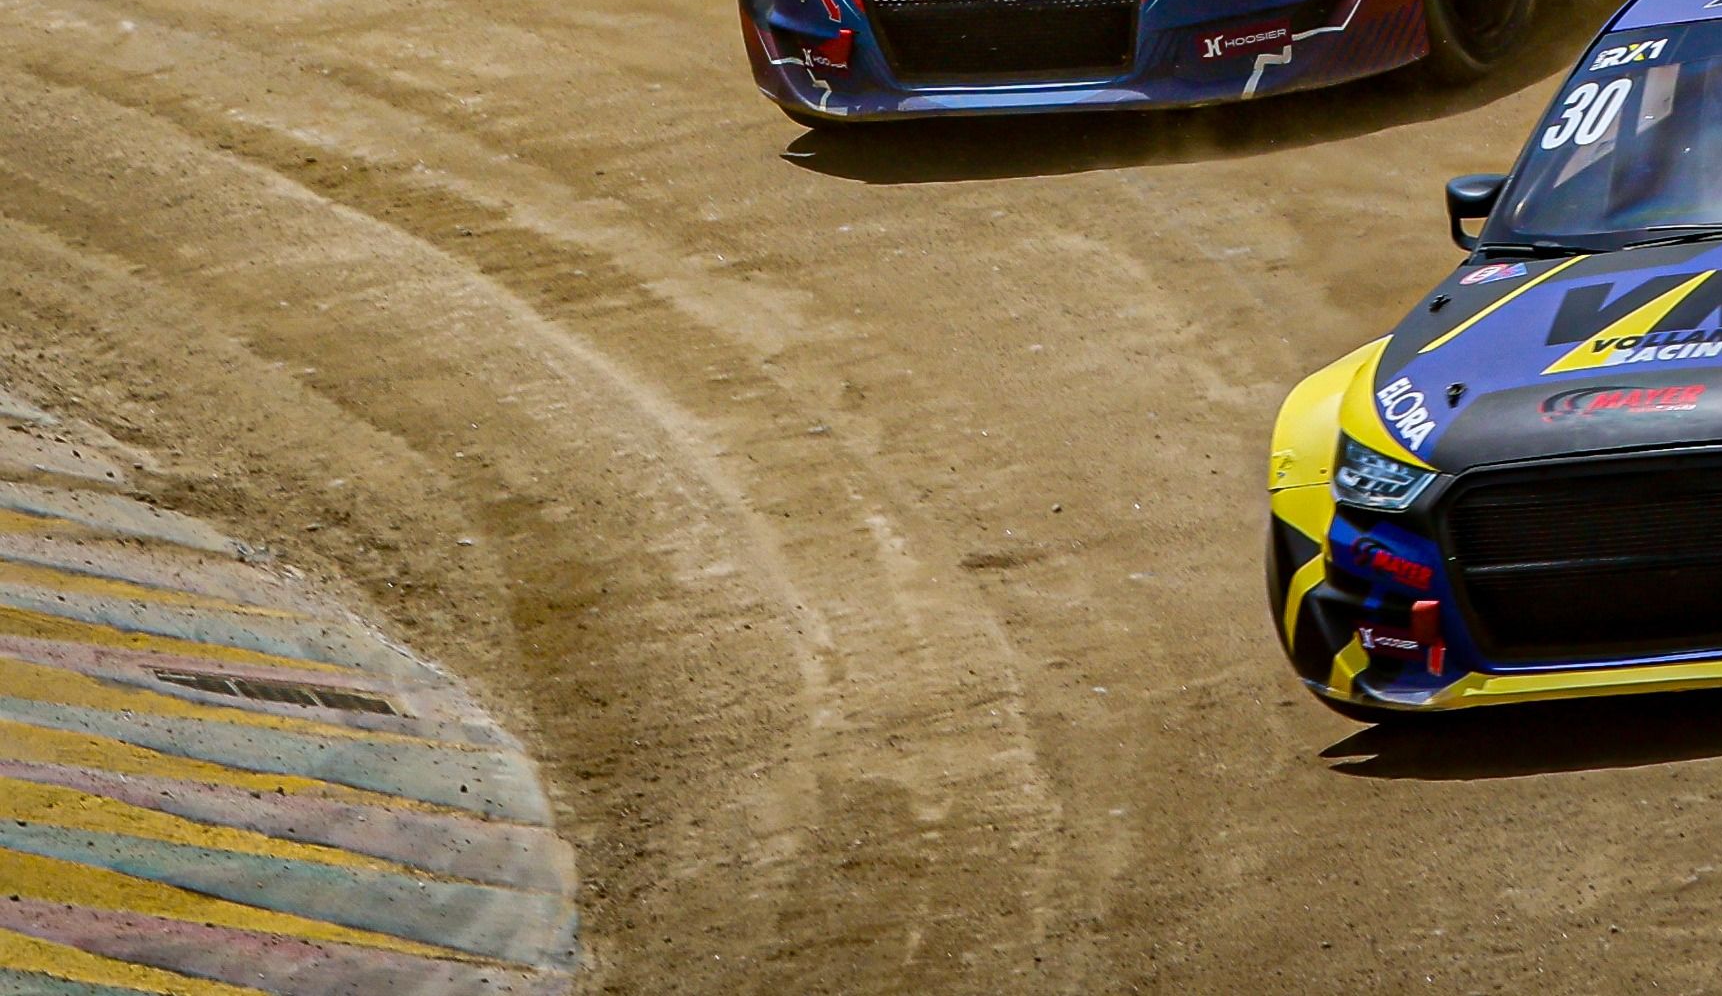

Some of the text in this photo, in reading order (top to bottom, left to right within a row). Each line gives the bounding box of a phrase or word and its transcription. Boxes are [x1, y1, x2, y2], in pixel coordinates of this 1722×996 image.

[1224, 28, 1287, 49] HOOSIER
[1540, 78, 1632, 151] 30
[1376, 377, 1436, 452] ELORA
